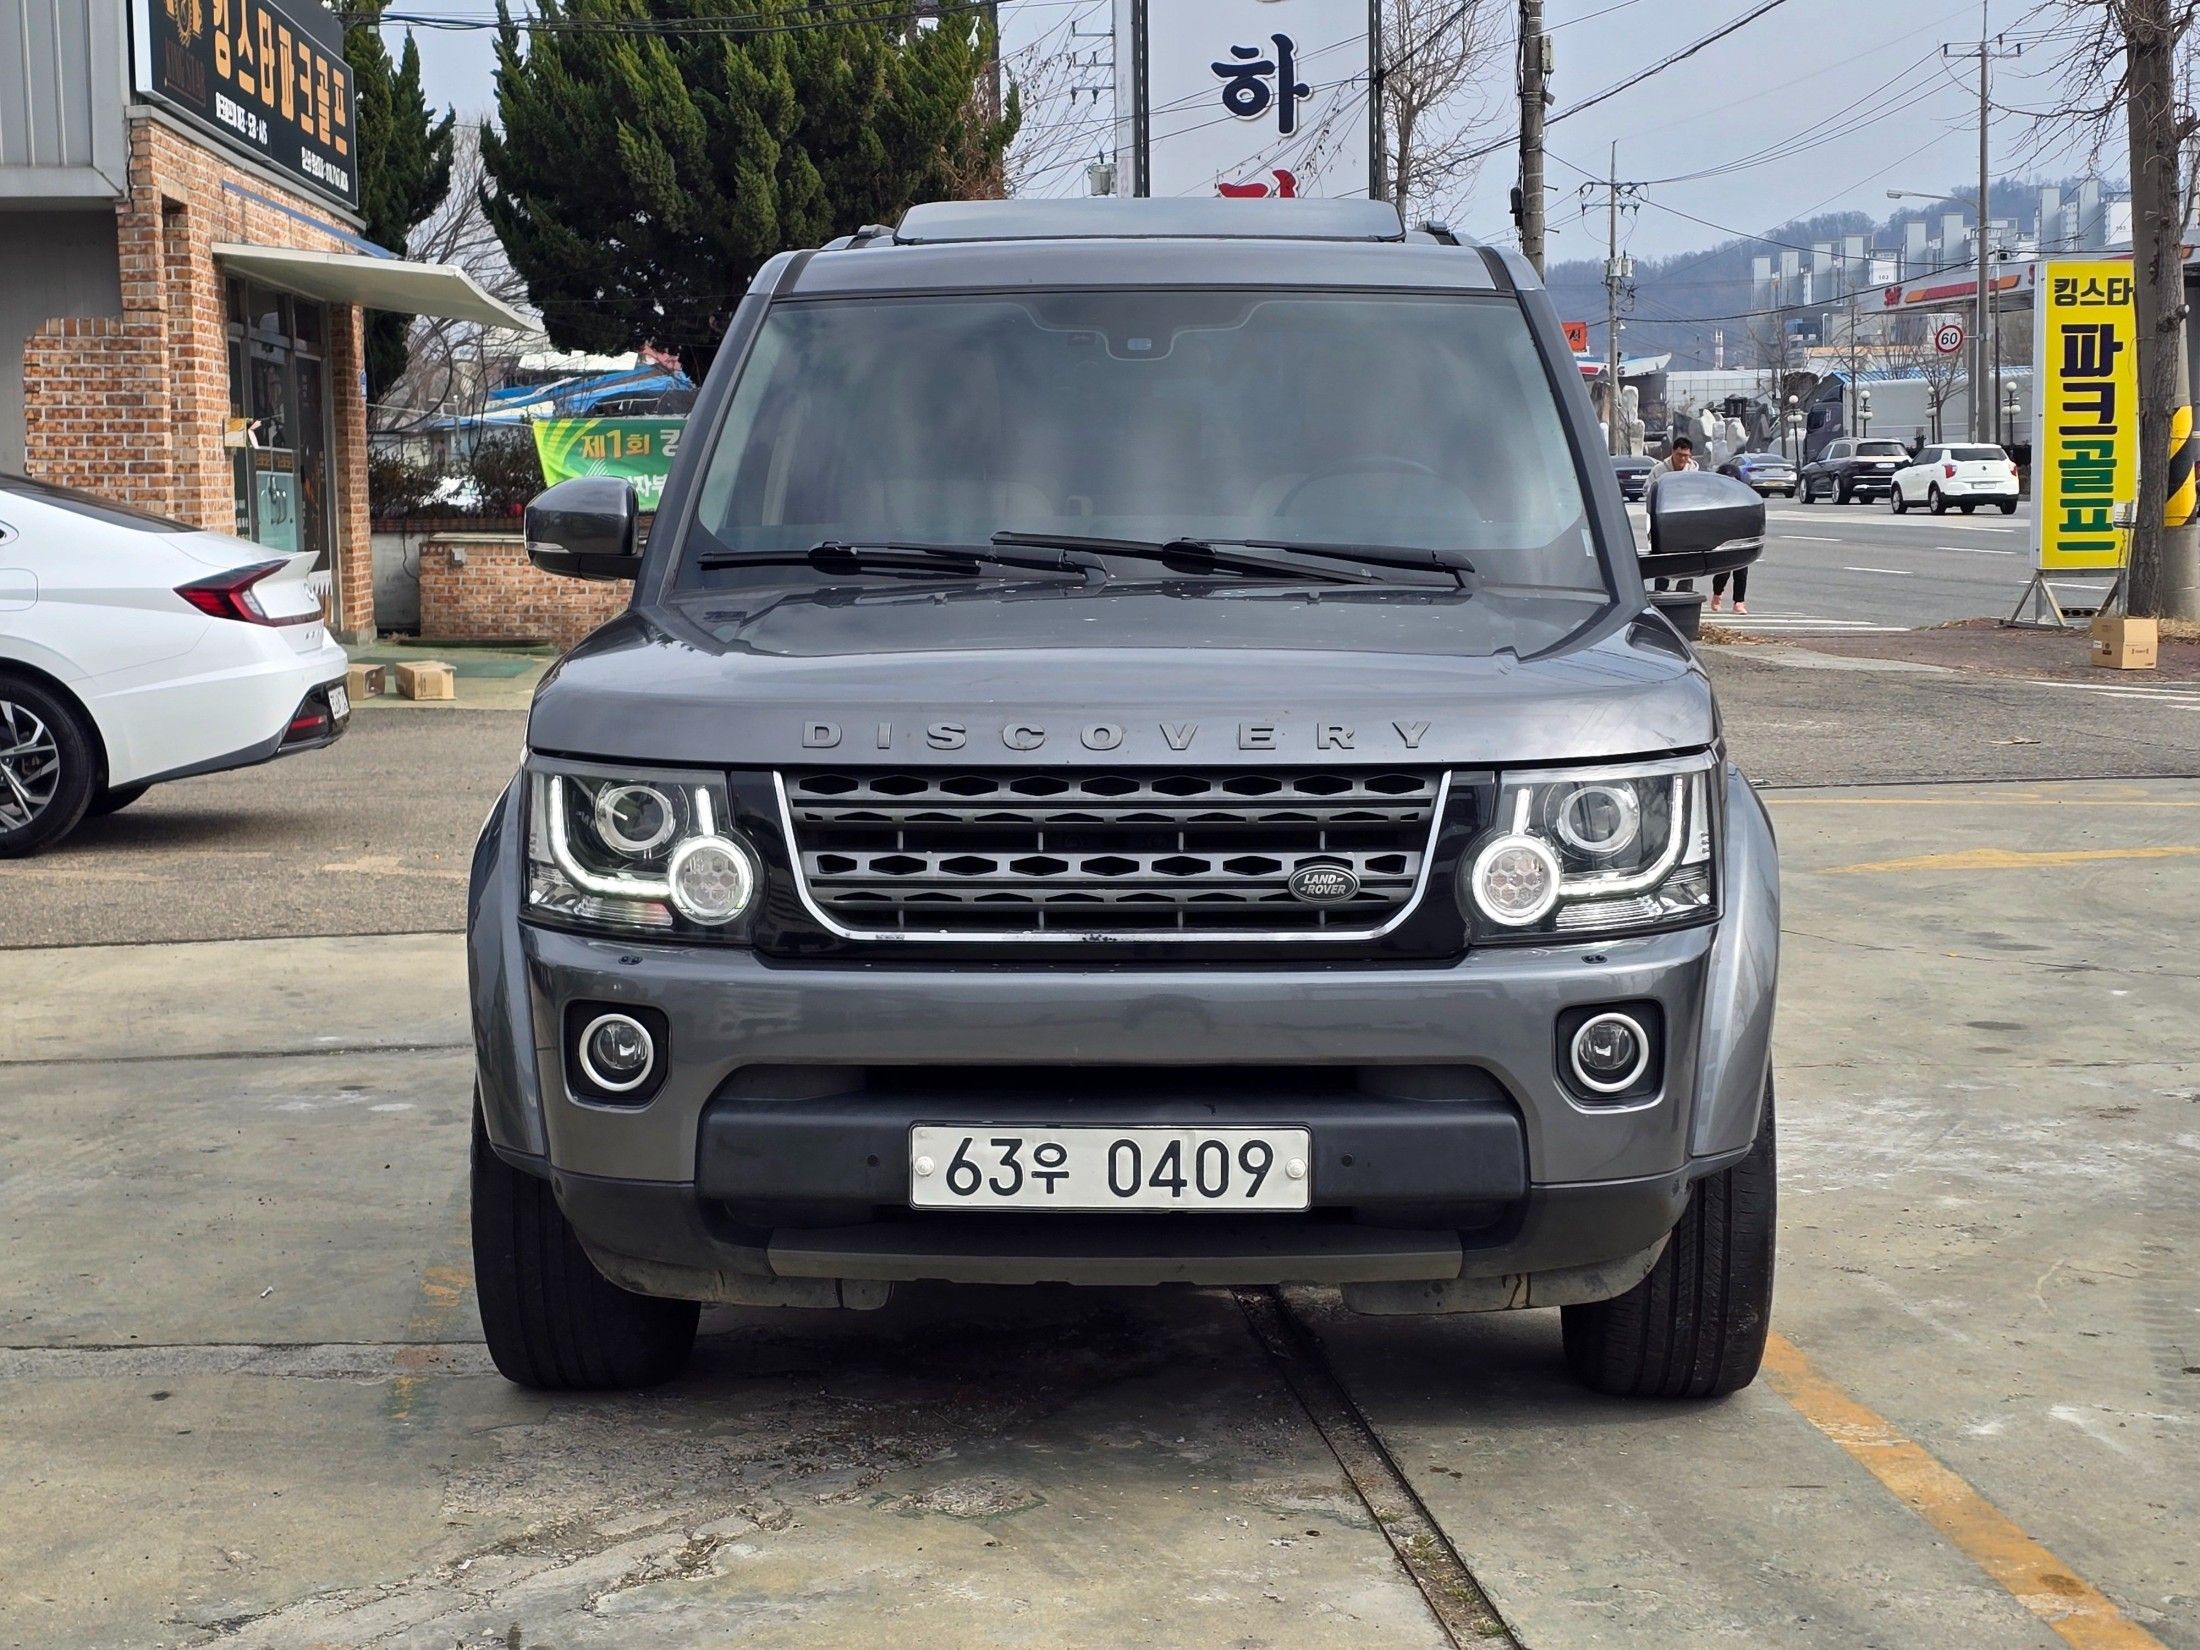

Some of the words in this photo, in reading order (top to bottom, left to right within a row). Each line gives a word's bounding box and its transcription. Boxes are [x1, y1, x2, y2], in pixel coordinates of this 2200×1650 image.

[2054, 278, 2133, 306] 킹스타
[1941, 332, 1958, 345] 60
[581, 429, 650, 459] 제1회
[2057, 324, 2123, 551] 파크골프
[802, 721, 1431, 750] DISCOVERY
[1306, 884, 1346, 894] ROVER
[946, 1137, 1069, 1196] 63우
[1108, 1138, 1274, 1198] 0409
